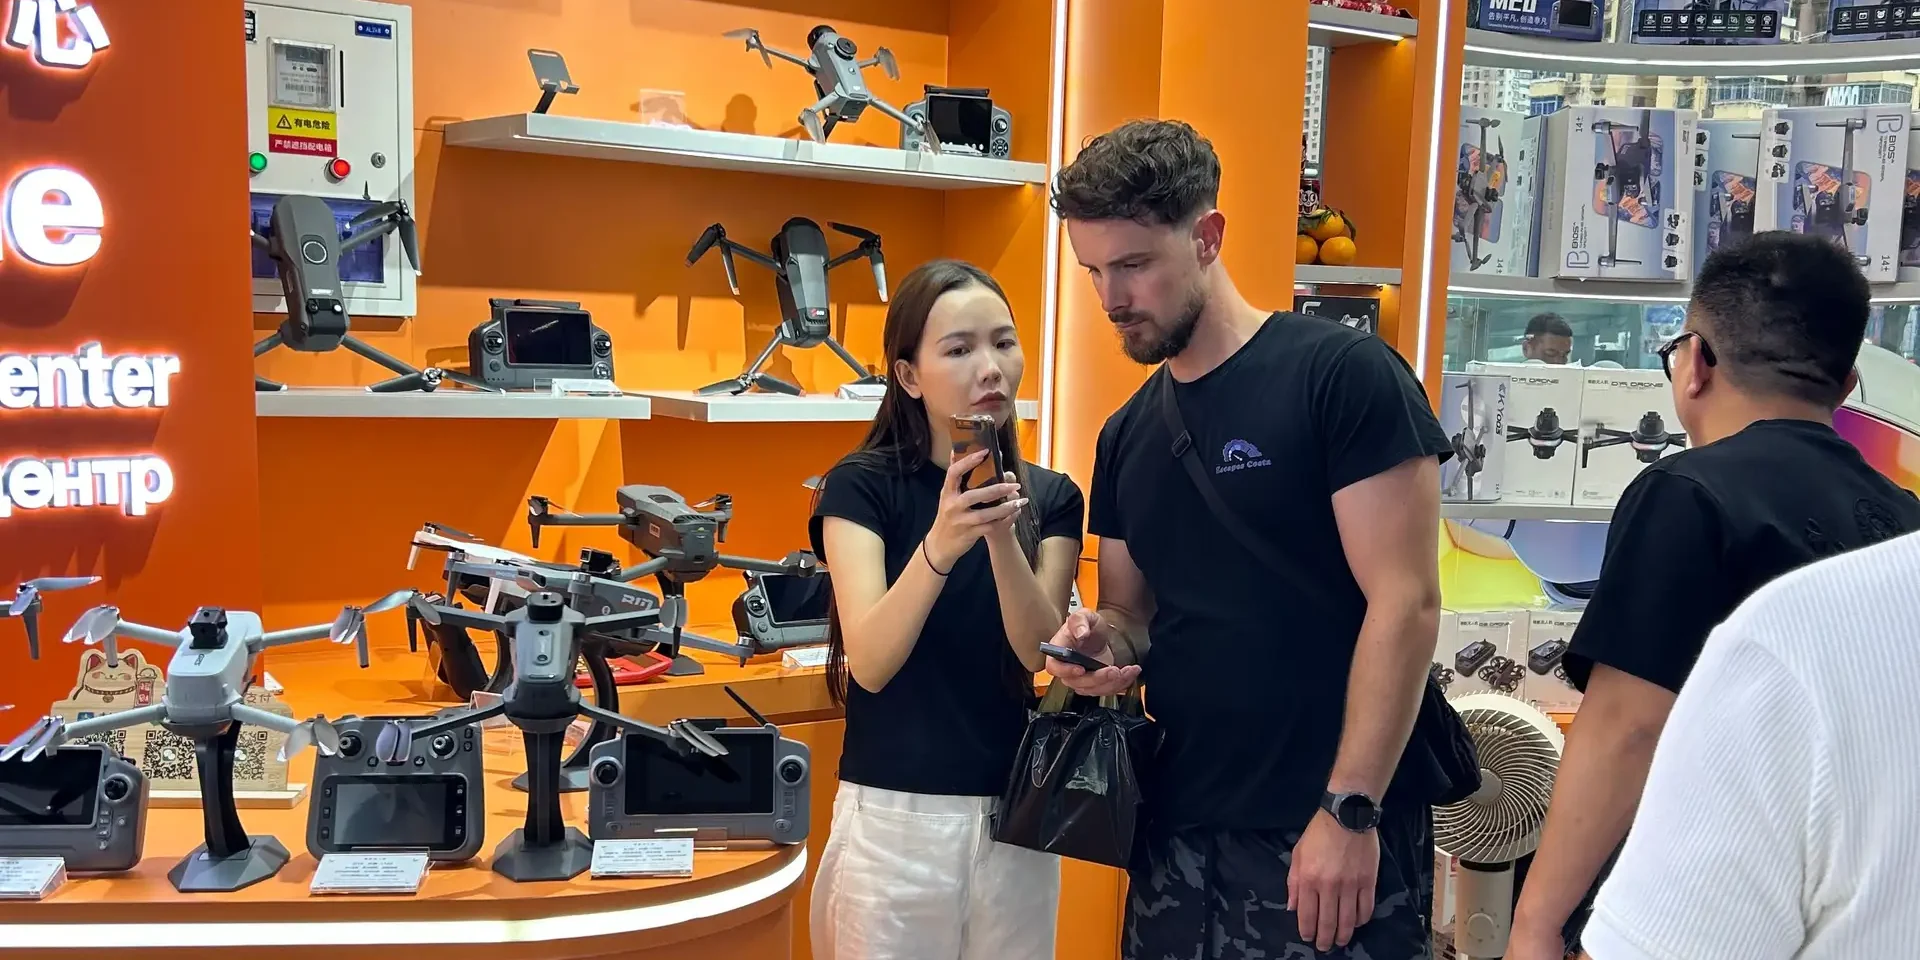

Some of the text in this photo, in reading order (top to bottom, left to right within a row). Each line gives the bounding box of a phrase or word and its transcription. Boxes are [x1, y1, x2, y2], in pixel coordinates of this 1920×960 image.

[6, 0, 110, 68] 心
[274, 139, 332, 153] 严禁遮挡配电箱
[294, 118, 331, 130] 有电危险
[0, 166, 105, 267] e
[0, 341, 181, 409] enter
